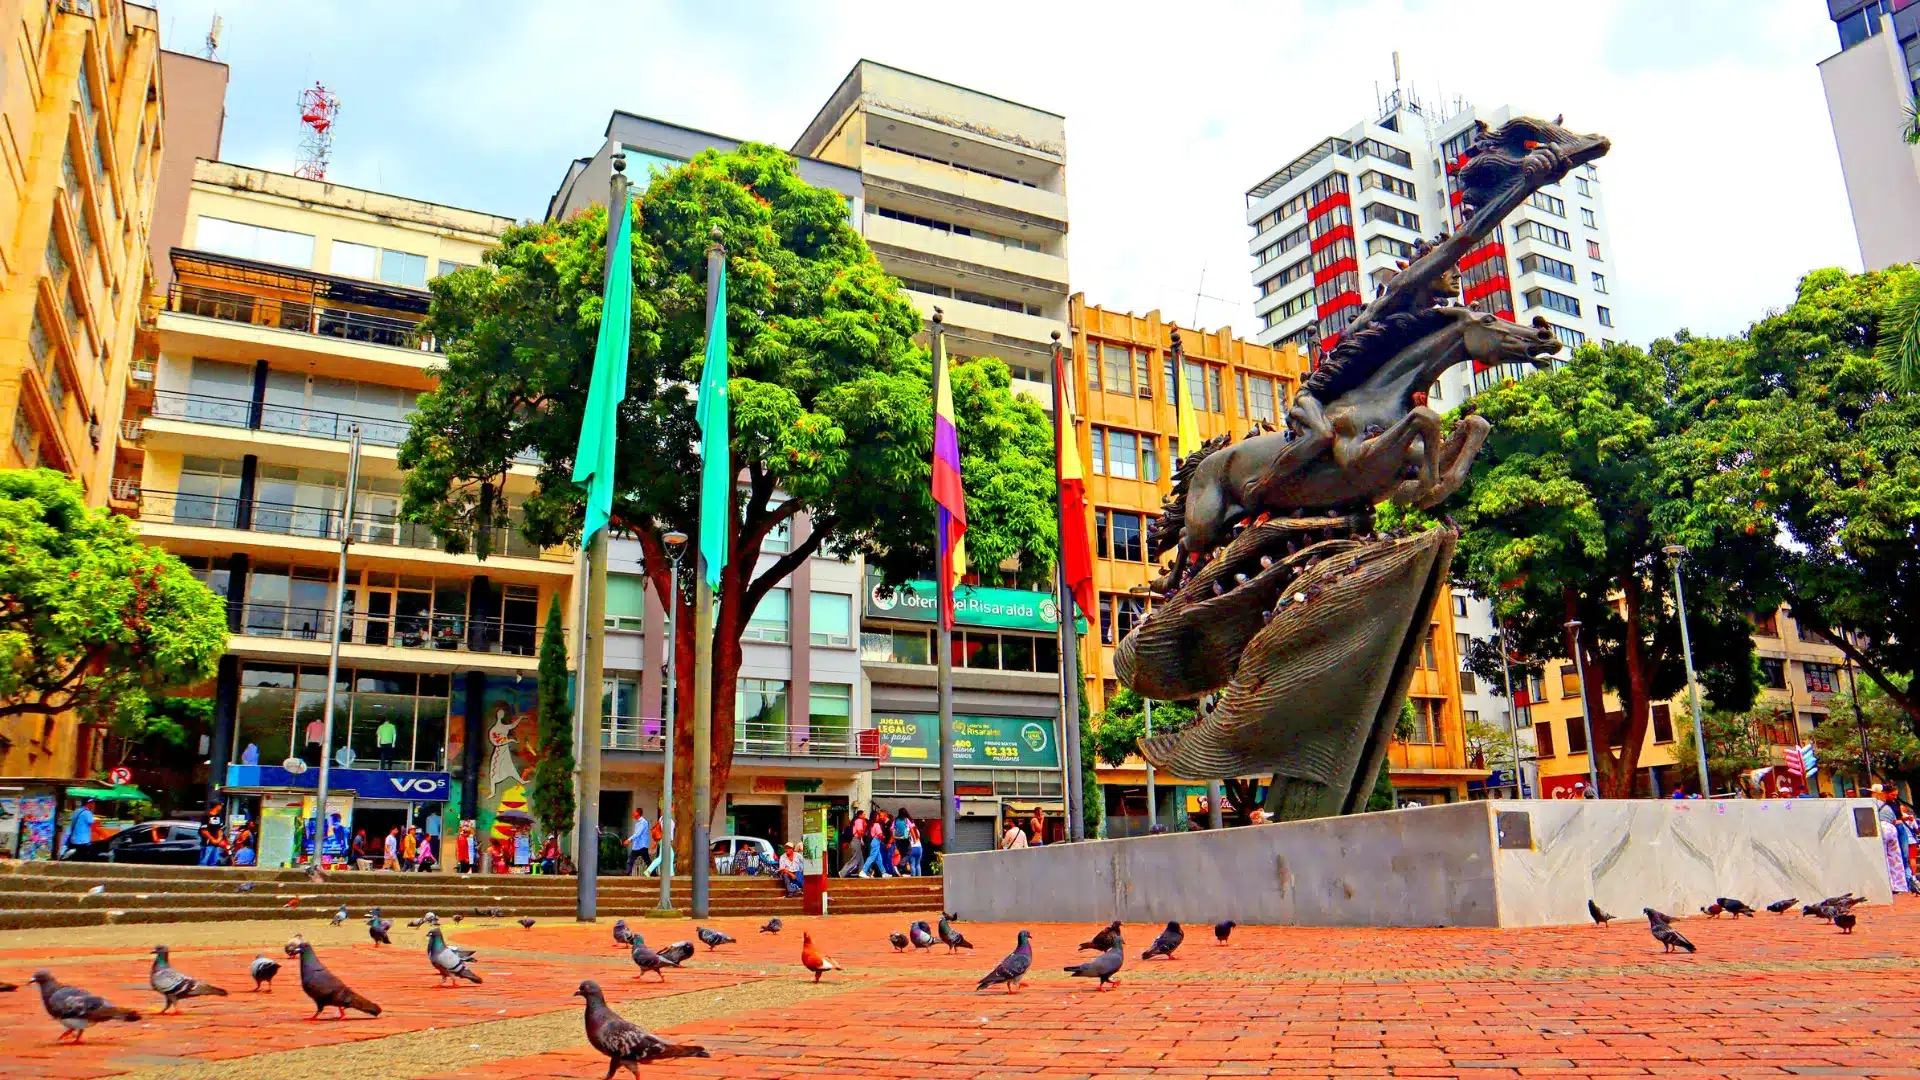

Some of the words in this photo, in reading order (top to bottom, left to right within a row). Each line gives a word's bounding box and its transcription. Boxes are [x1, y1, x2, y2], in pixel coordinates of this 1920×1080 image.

[900, 592, 938, 609] Loterí
[969, 599, 1033, 617] Risaralda
[879, 725, 907, 734] LEGAL
[891, 734, 912, 743] paga
